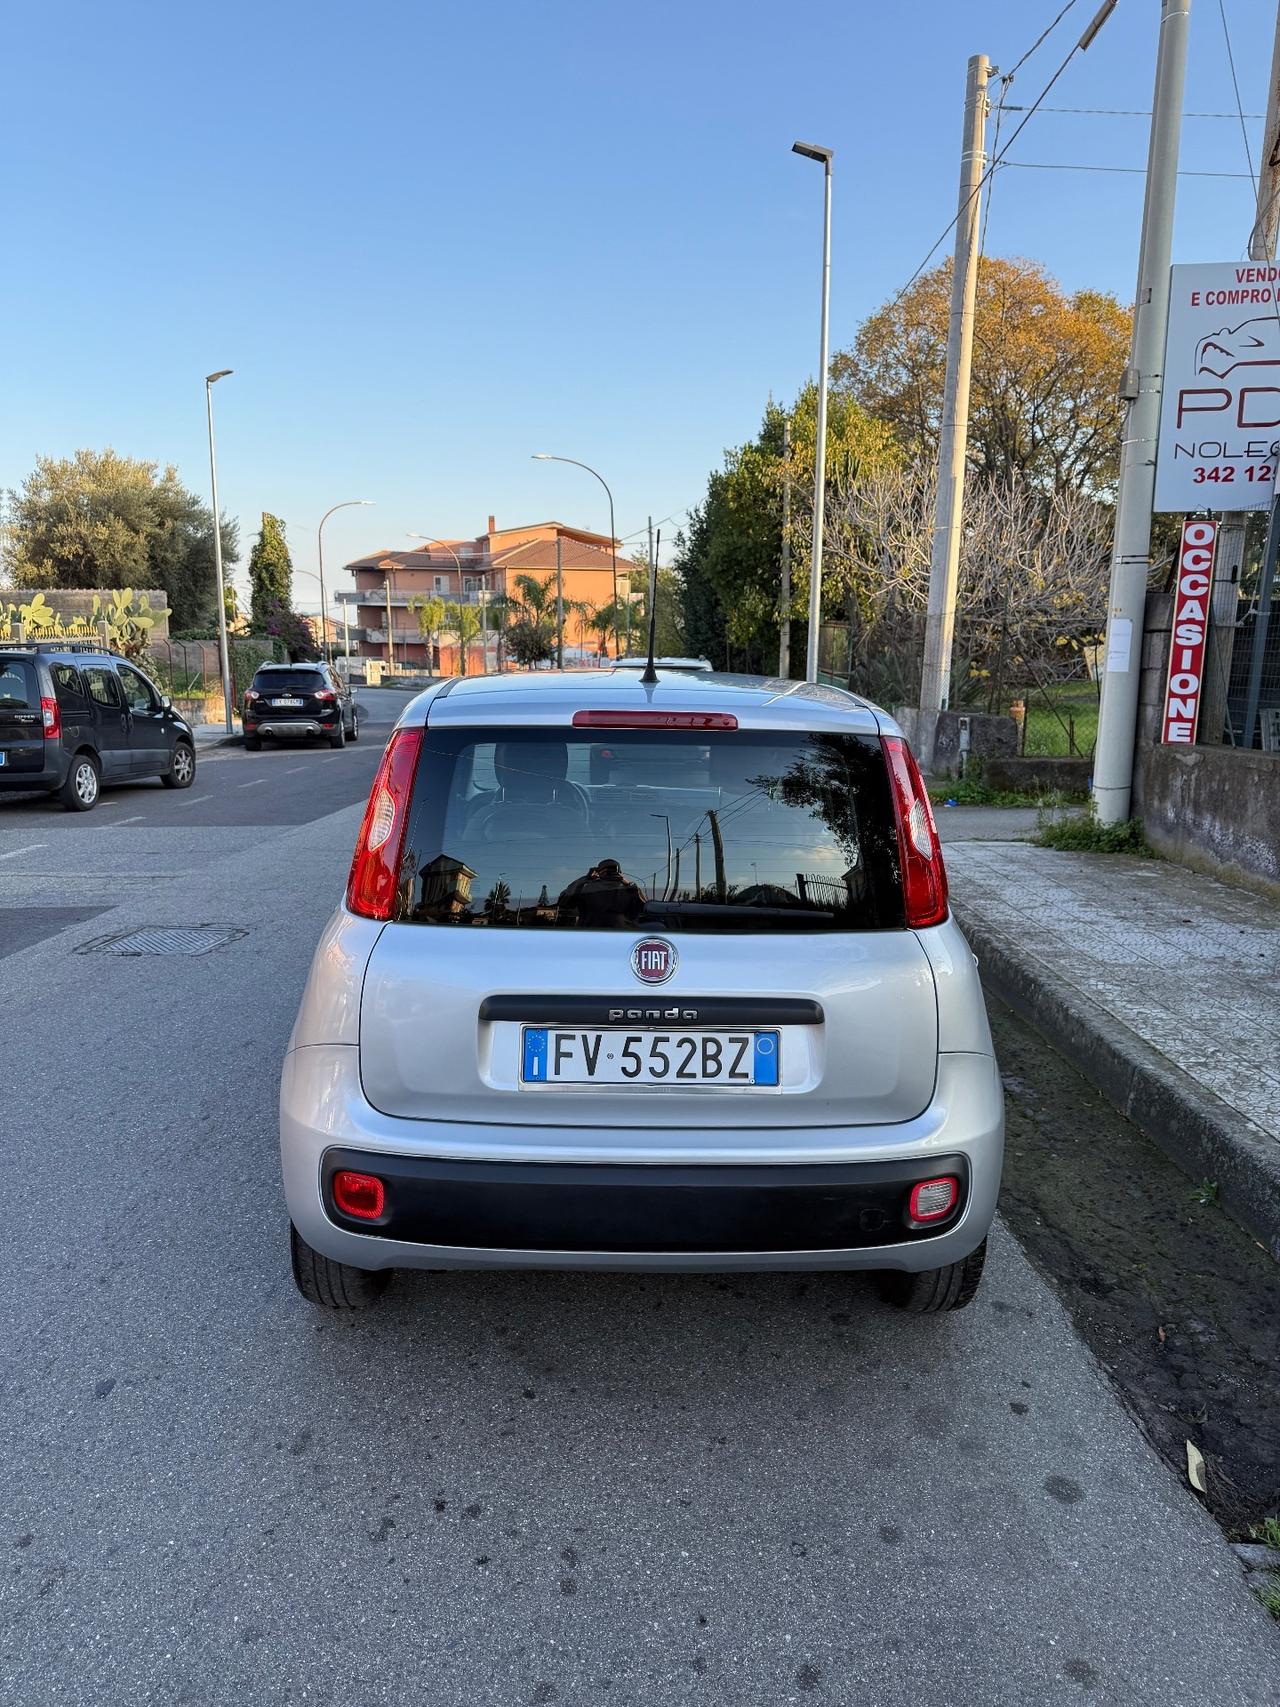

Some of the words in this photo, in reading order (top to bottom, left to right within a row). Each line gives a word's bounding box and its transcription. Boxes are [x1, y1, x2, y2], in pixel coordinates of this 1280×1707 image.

[1235, 267, 1280, 283] VEND
[1191, 292, 1200, 306] E
[1206, 288, 1271, 305] COMPRO
[1193, 466, 1235, 483] 342
[1168, 523, 1215, 742] OCCASIONE
[641, 951, 667, 970] FIAT
[609, 1007, 698, 1021] panda
[621, 1036, 749, 1078] 552BZ
